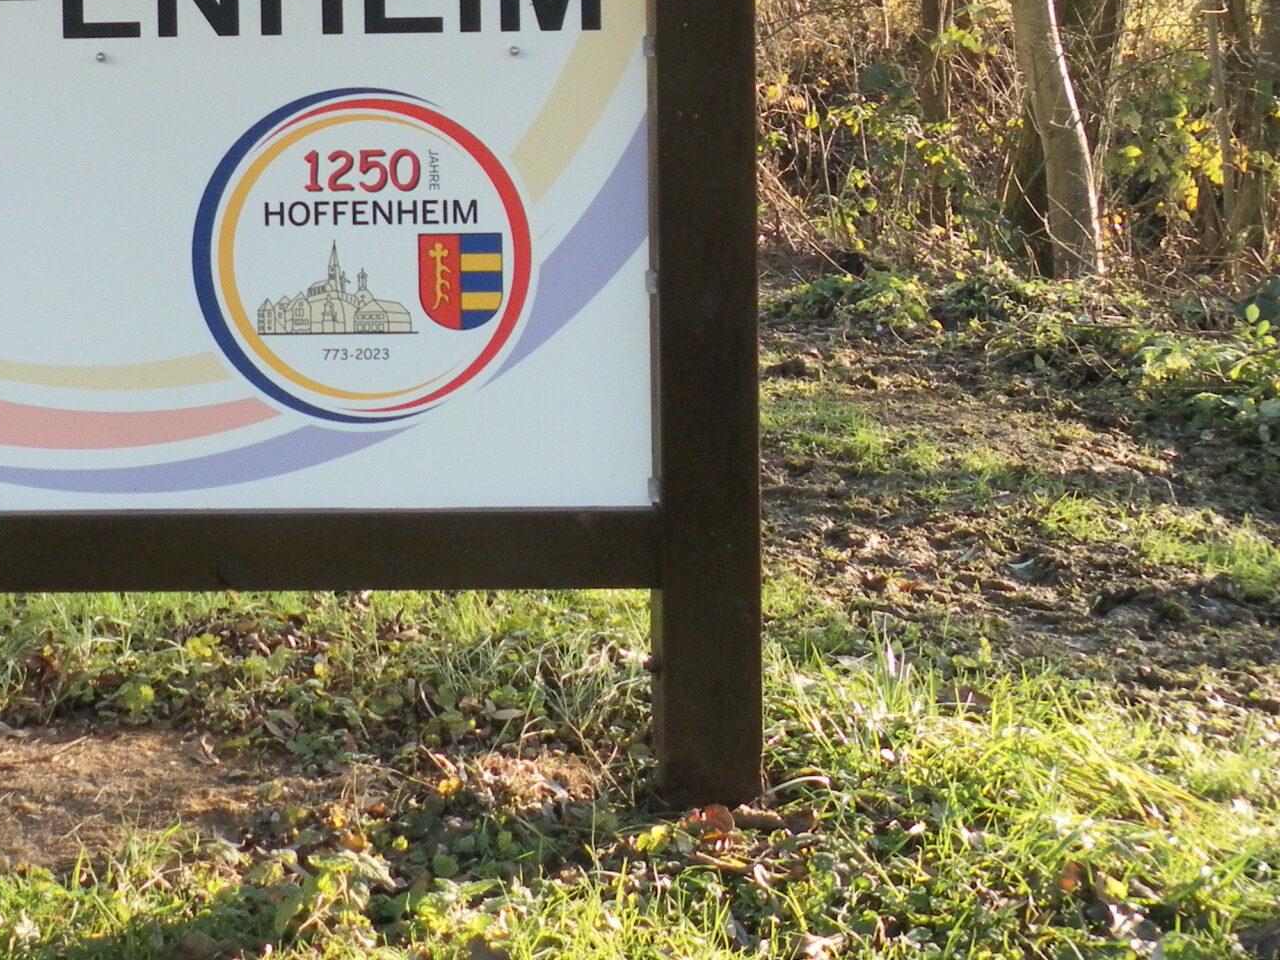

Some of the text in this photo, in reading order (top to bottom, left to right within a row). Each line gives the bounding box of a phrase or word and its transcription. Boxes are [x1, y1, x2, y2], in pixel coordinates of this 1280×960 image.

[304, 148, 421, 193] 1250
[428, 149, 440, 191] JAHRE
[264, 199, 478, 227] HOFFENHEIM
[322, 347, 390, 361] 773-2023
